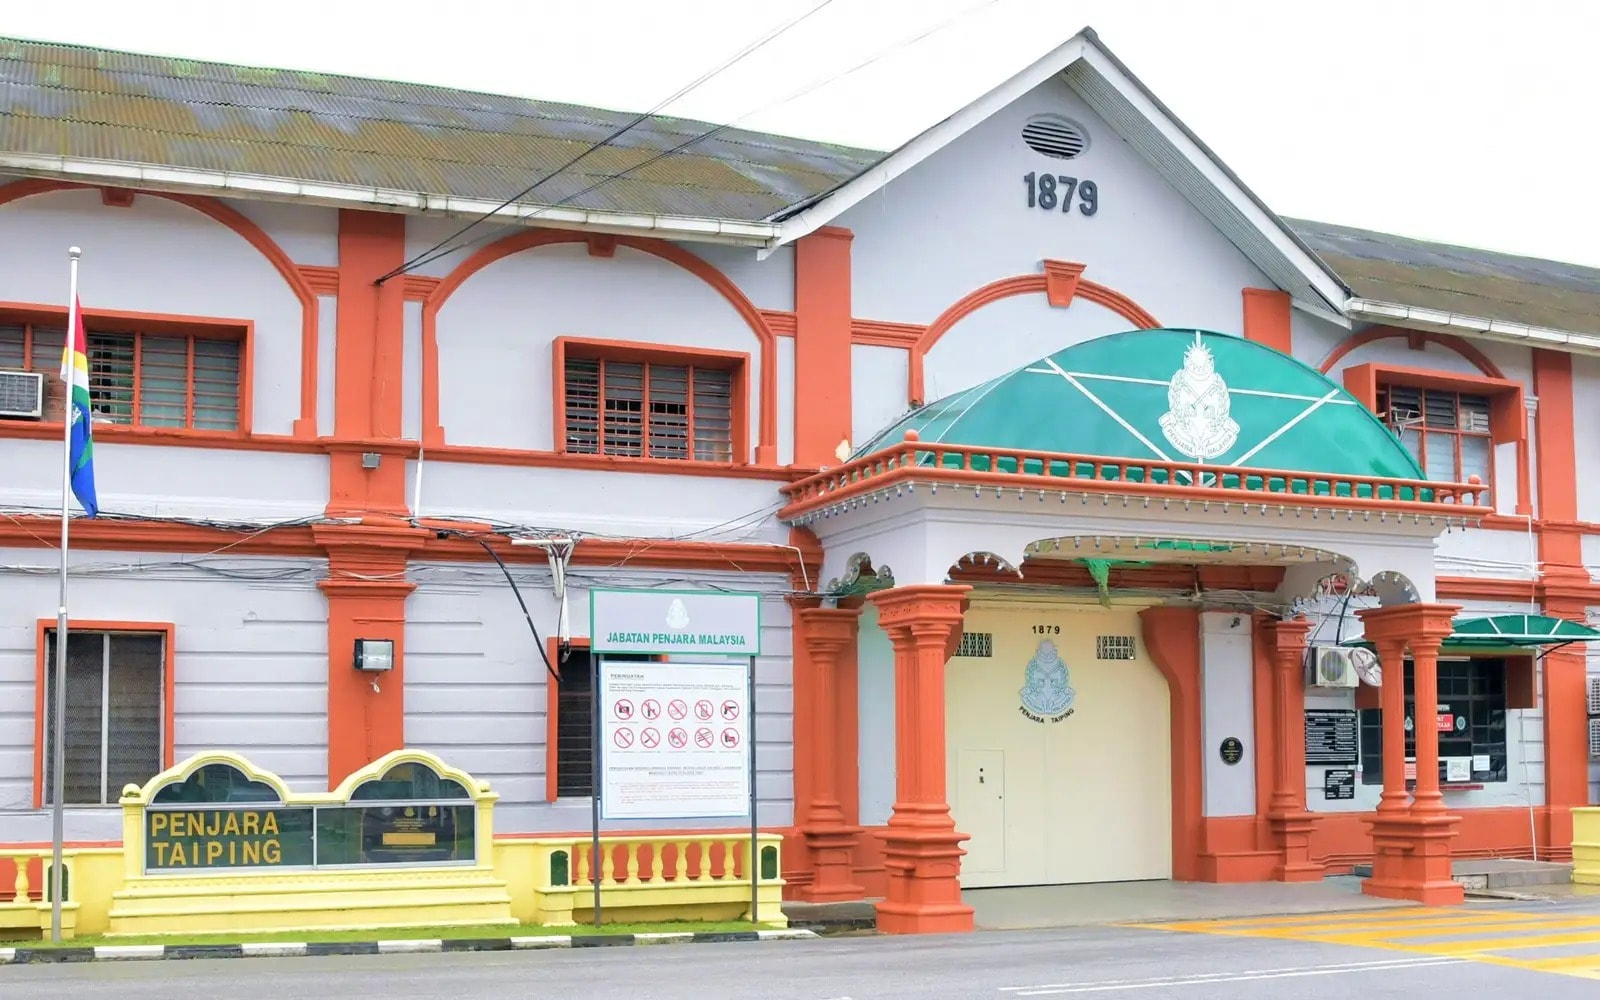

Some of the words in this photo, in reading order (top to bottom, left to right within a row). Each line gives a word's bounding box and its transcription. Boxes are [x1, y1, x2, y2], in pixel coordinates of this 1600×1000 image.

[1023, 171, 1098, 217] 1879
[606, 632, 650, 643] JABATAN
[652, 633, 696, 644] PENJARA
[699, 634, 746, 646] MALAYSIA
[1032, 625, 1060, 635] 1879
[1018, 705, 1045, 723] PENJARA
[1050, 708, 1075, 723] TAIPING
[151, 811, 280, 837] PENJARA
[152, 839, 281, 866] TAIPING
